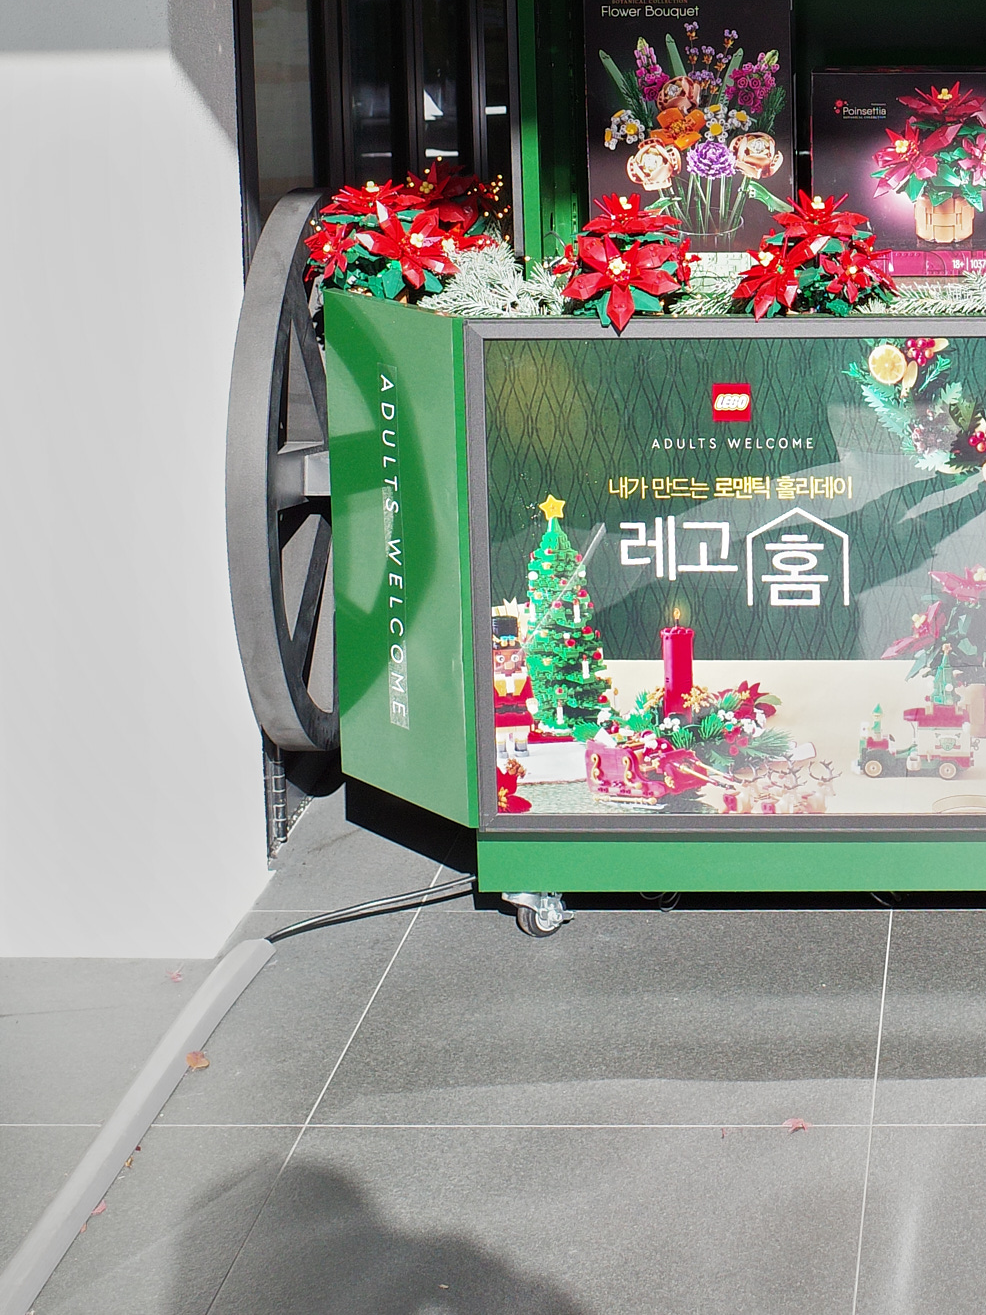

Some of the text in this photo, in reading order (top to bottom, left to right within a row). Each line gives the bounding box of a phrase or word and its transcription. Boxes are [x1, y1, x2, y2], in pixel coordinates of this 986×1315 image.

[601, 5, 700, 19] Flower Bouquet
[842, 106, 887, 115] Poinsettia
[952, 259, 964, 269] 18+
[714, 393, 750, 411] LEGO
[651, 437, 814, 450] ADULTS WELCOME
[608, 475, 853, 500] 내가 만드는 로맨틱 홀리데이
[379, 373, 407, 718] ADULTS WELCOME
[619, 515, 829, 606] 레고 홈
